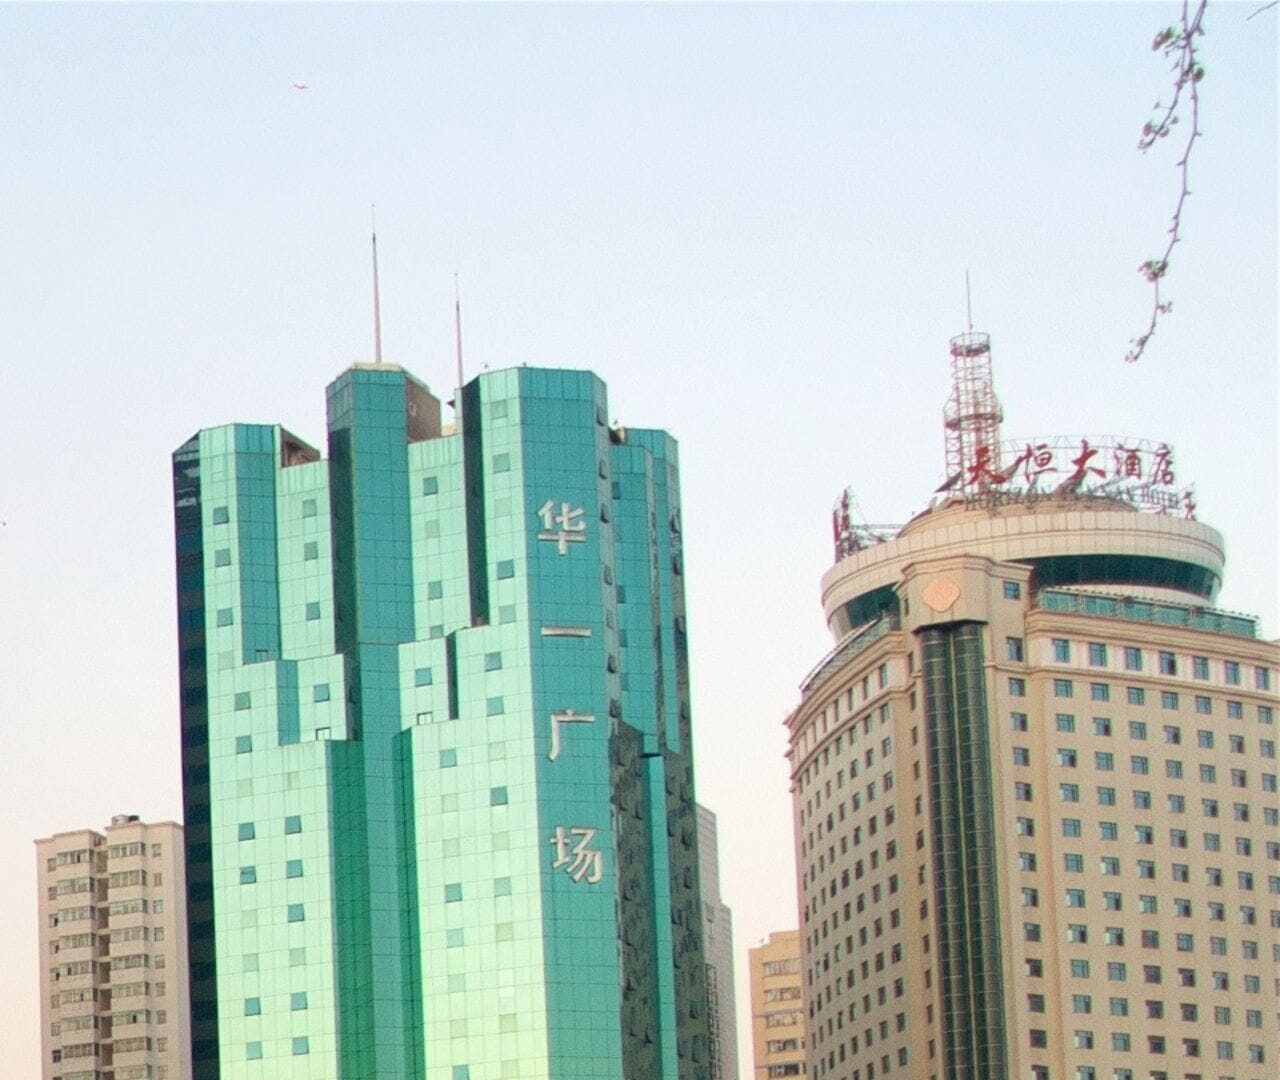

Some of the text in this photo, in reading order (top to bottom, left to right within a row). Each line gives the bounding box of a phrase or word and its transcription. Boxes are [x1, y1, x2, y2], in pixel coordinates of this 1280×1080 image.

[967, 439, 1176, 486] 天恒大酒店
[538, 499, 602, 884] 华一广场
